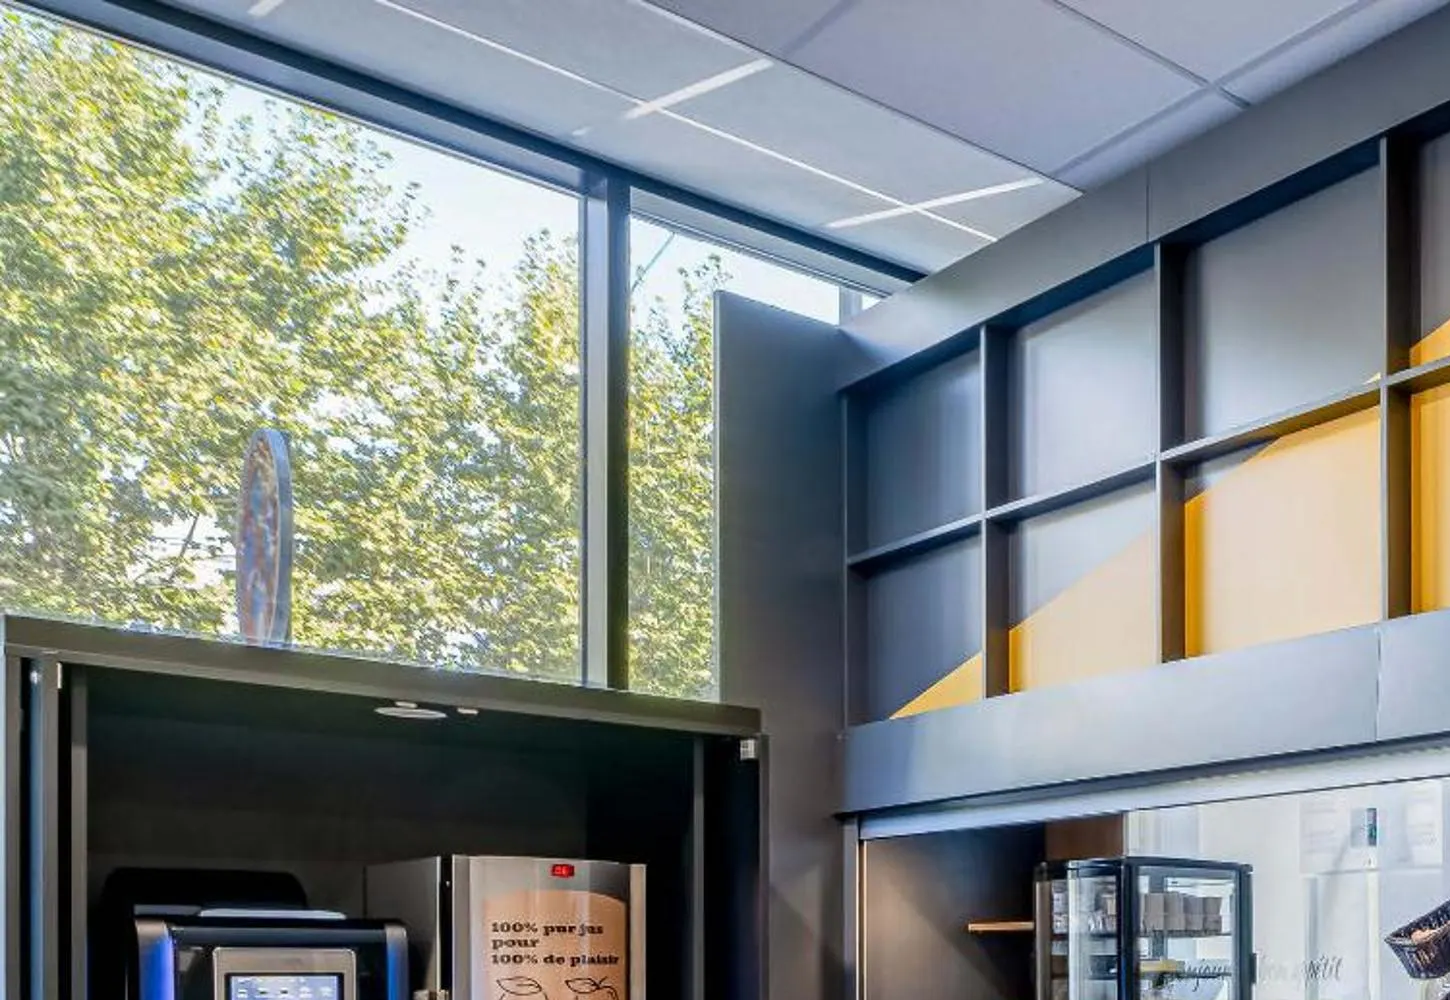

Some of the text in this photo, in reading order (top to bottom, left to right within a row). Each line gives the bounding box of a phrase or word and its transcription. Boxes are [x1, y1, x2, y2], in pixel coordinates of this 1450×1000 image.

[491, 922, 604, 936] 100% pur jus
[491, 938, 539, 949] pour
[491, 953, 620, 967] 100% de plaisir
